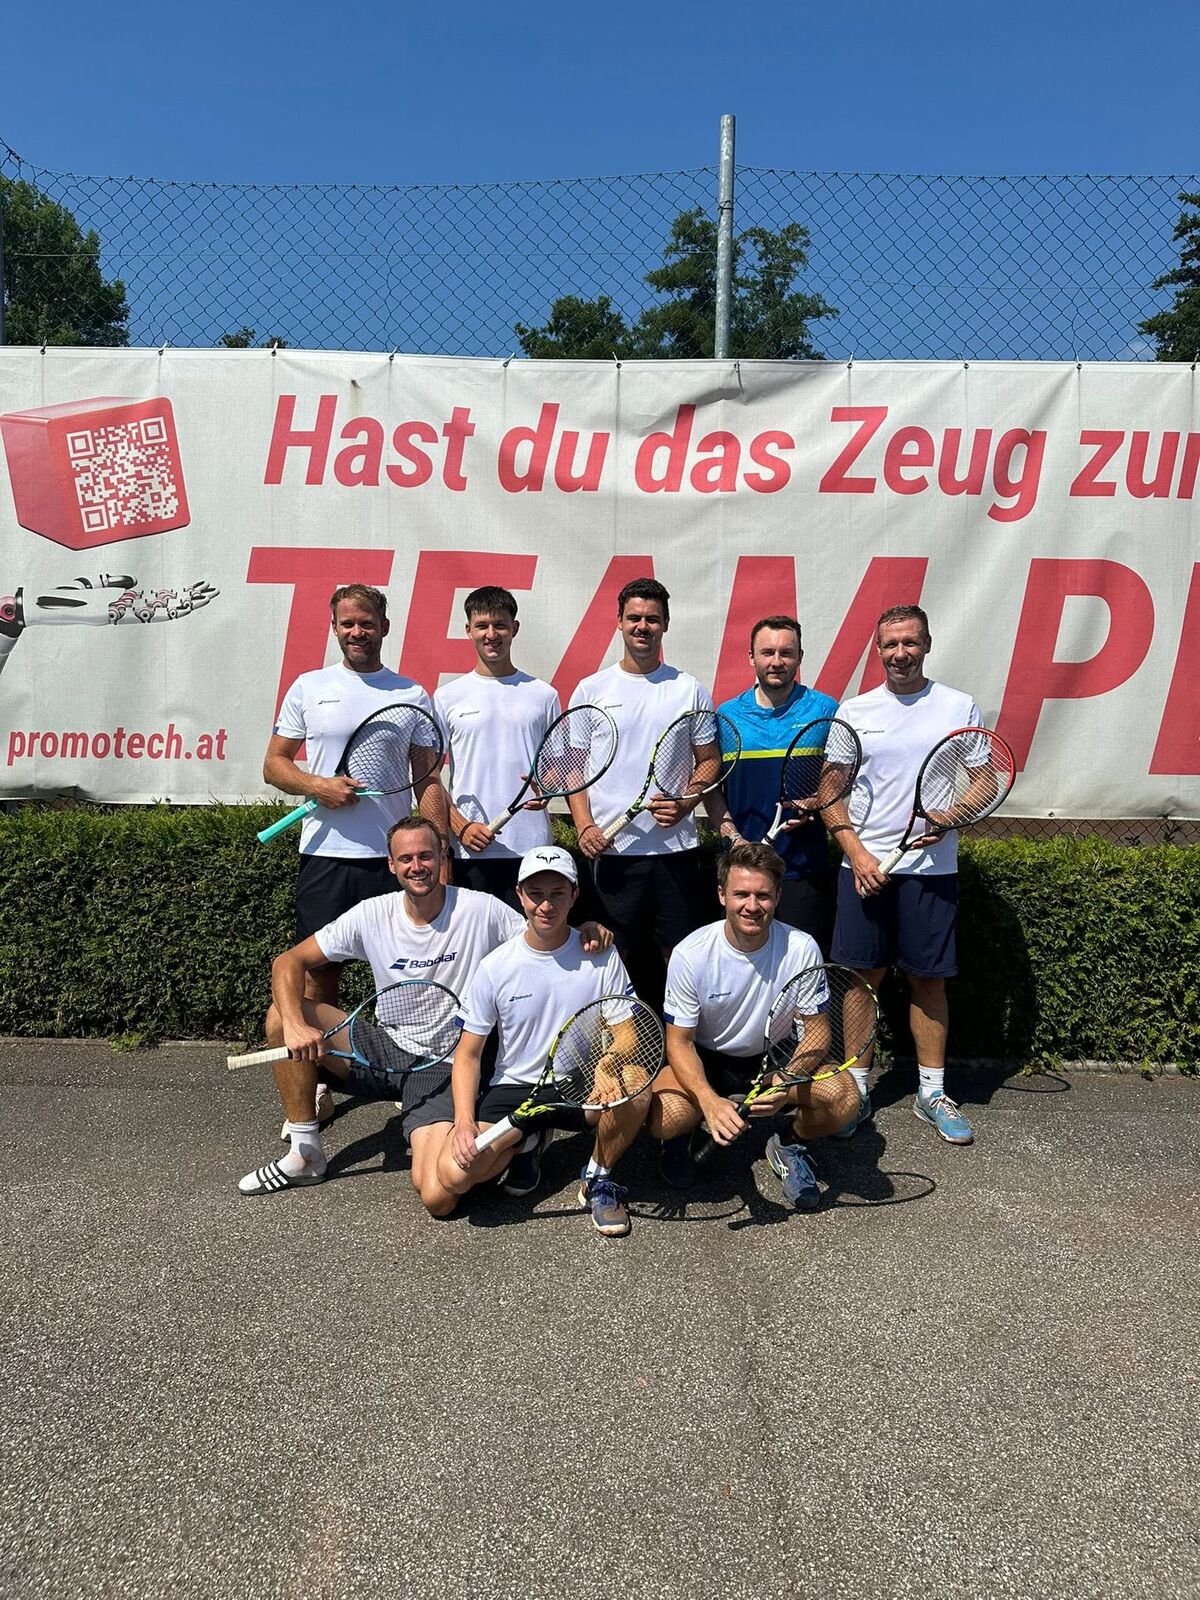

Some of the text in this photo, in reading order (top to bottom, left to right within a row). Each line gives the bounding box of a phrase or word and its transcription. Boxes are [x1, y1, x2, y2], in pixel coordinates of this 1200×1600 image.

[263, 394, 476, 492] Hast
[497, 402, 609, 494] du
[634, 405, 795, 494] das
[819, 406, 1047, 523] Zeug
[996, 557, 1200, 776] P
[7, 723, 228, 766] promotech.at
